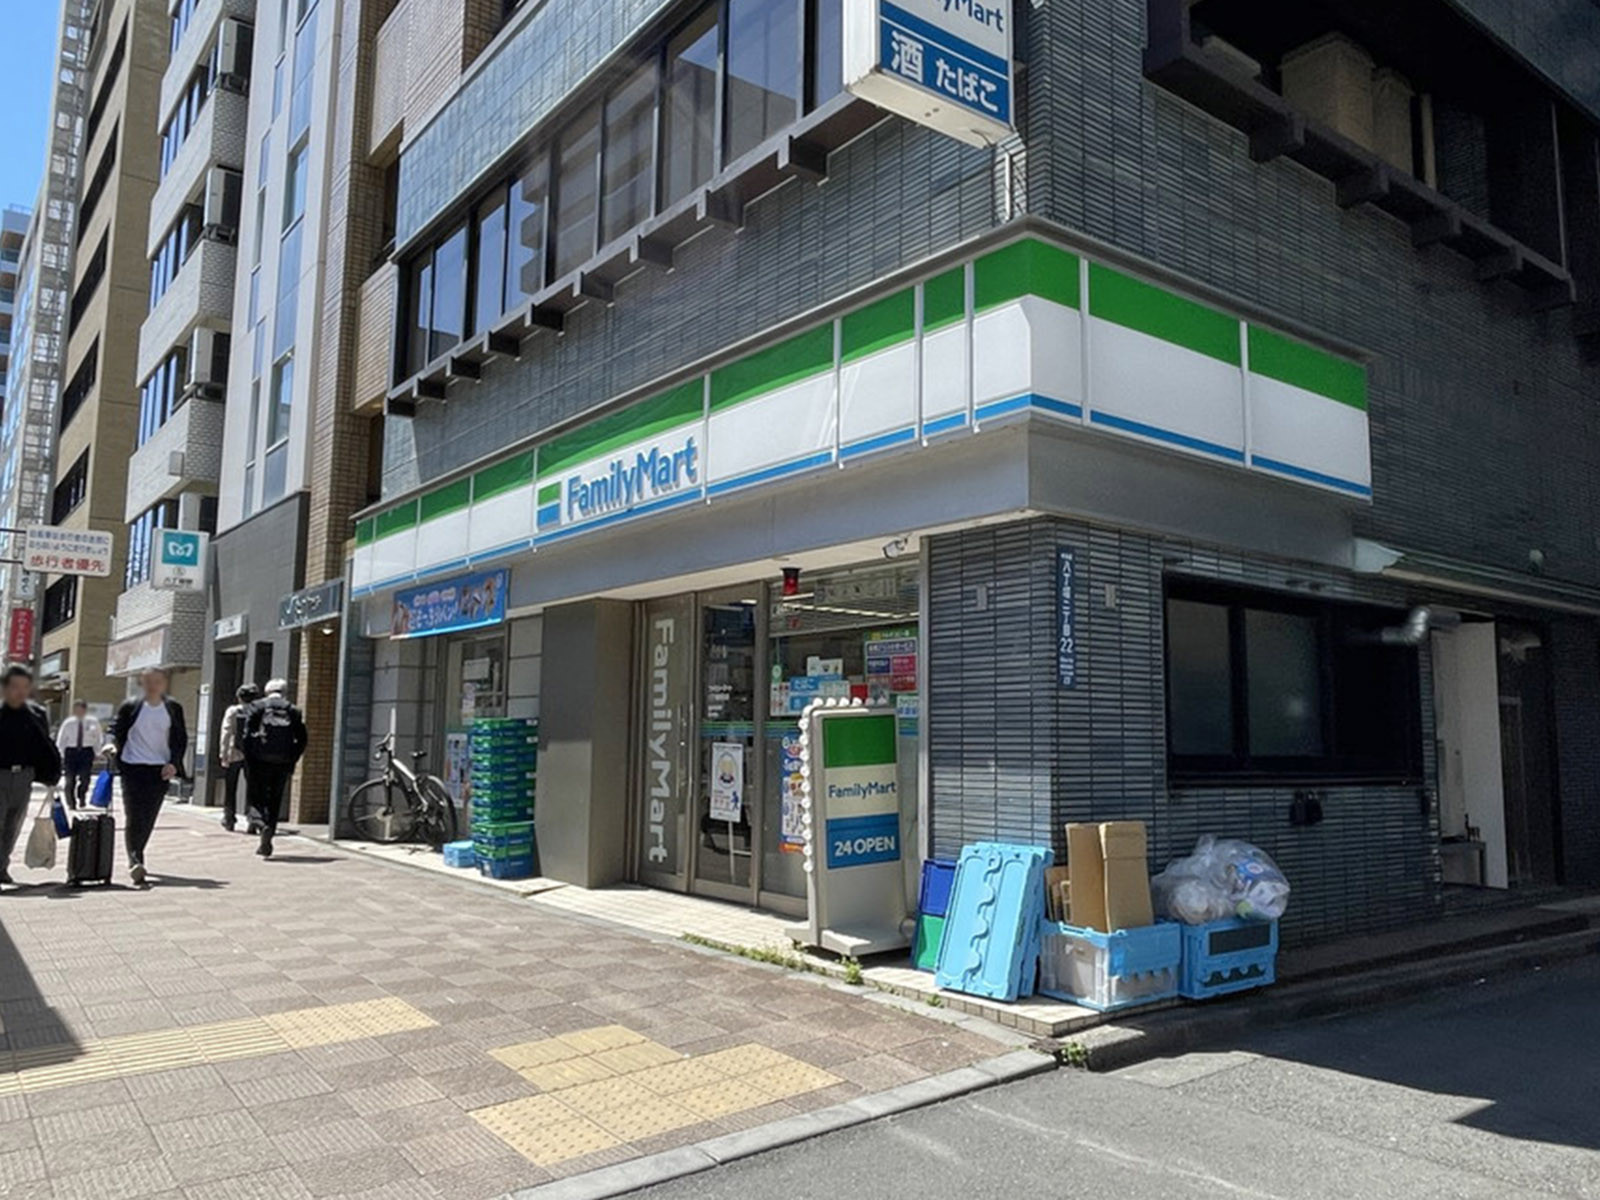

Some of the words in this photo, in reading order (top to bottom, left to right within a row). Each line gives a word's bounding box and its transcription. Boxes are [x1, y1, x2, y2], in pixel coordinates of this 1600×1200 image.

[891, 31, 924, 84] 酒
[936, 58, 999, 112] たばこ
[567, 436, 697, 518] FamilyMart
[30, 555, 105, 572] 歩行者優先
[1060, 638, 1073, 653] 22
[648, 618, 674, 864] FamilyMart
[828, 781, 897, 800] FamilyMart
[835, 840, 852, 857] 24
[854, 836, 895, 855] OPEN
